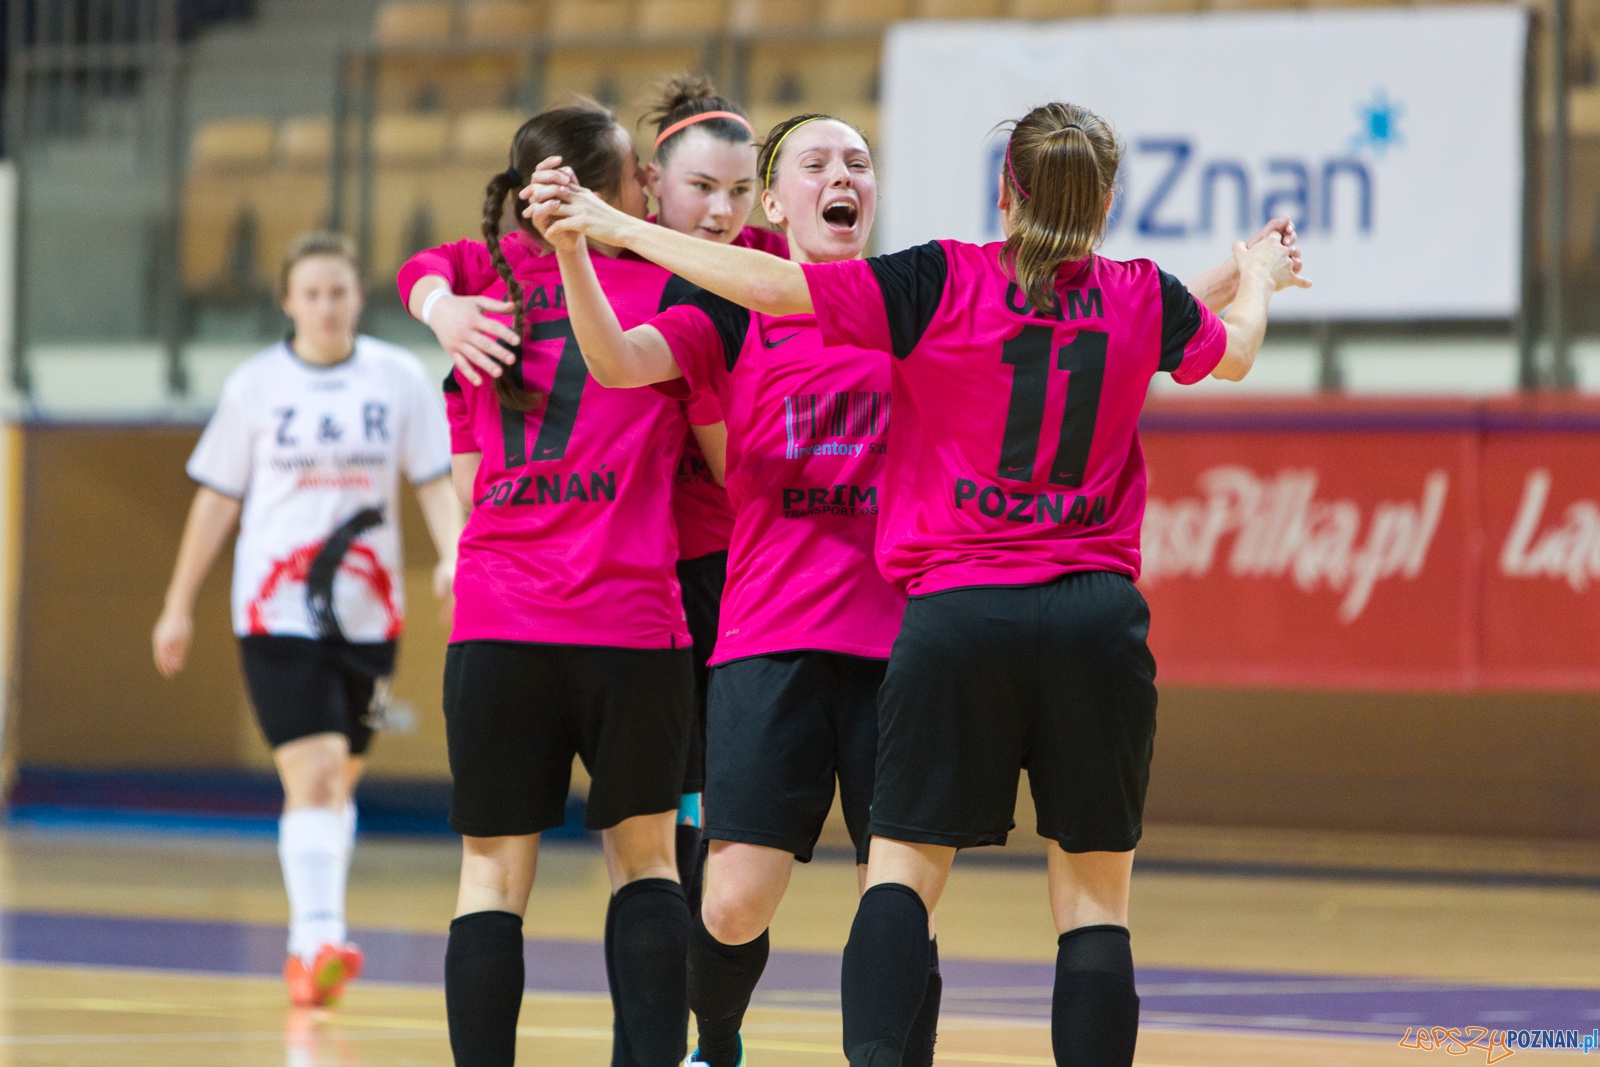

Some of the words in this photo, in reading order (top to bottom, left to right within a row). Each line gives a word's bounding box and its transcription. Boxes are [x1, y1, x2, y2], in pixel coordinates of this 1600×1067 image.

[488, 316, 590, 470] 17
[997, 323, 1109, 488] 11
[361, 400, 390, 443] R
[794, 441, 863, 458] inventory
[475, 463, 615, 507] POZNAŃ
[783, 505, 857, 519] TRANSPORT
